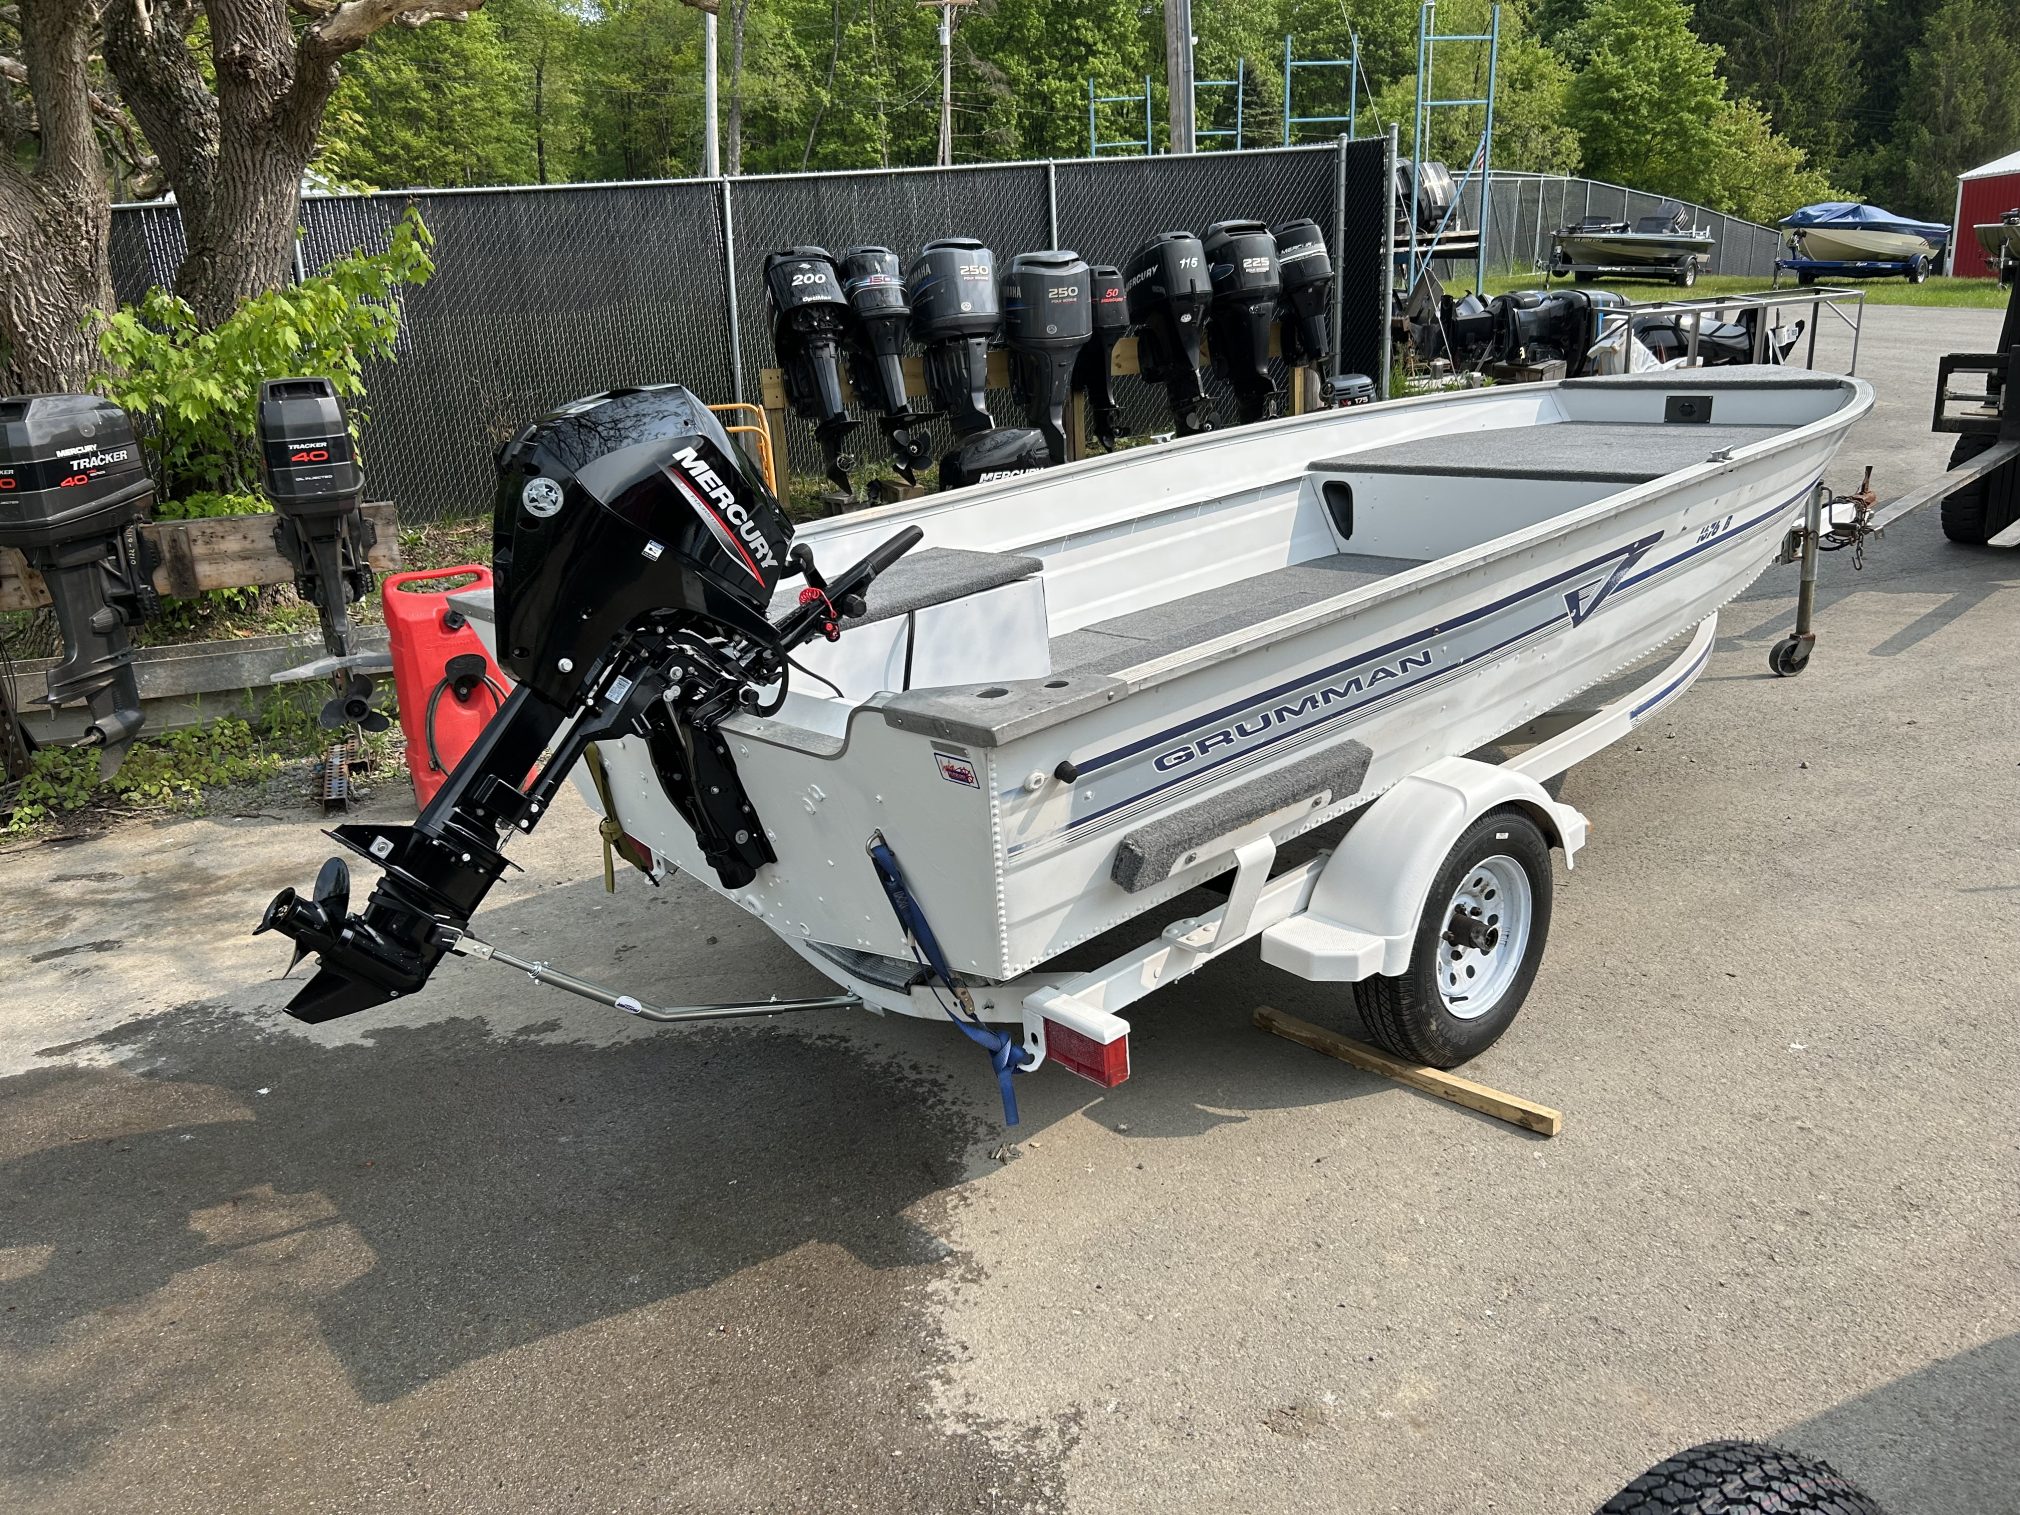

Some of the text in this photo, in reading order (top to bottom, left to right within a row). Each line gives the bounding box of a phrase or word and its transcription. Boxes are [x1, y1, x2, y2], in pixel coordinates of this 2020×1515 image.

[1180, 257, 1198, 269] 115
[1242, 257, 1270, 270] 225
[960, 265, 989, 275] 250
[791, 273, 826, 286] 200
[1048, 286, 1078, 299] 250
[1105, 288, 1119, 298] 50
[802, 295, 832, 303] OptiMax
[1354, 396, 1368, 405] 175
[56, 444, 97, 458] MERCURY
[288, 442, 327, 450] TRACKER
[70, 450, 128, 471] TRACKER
[291, 450, 329, 462] 40
[0, 478, 16, 489] 0
[60, 475, 88, 488] 40
[672, 446, 778, 568] MERCURY
[1153, 649, 1433, 773] GRUMMAN
